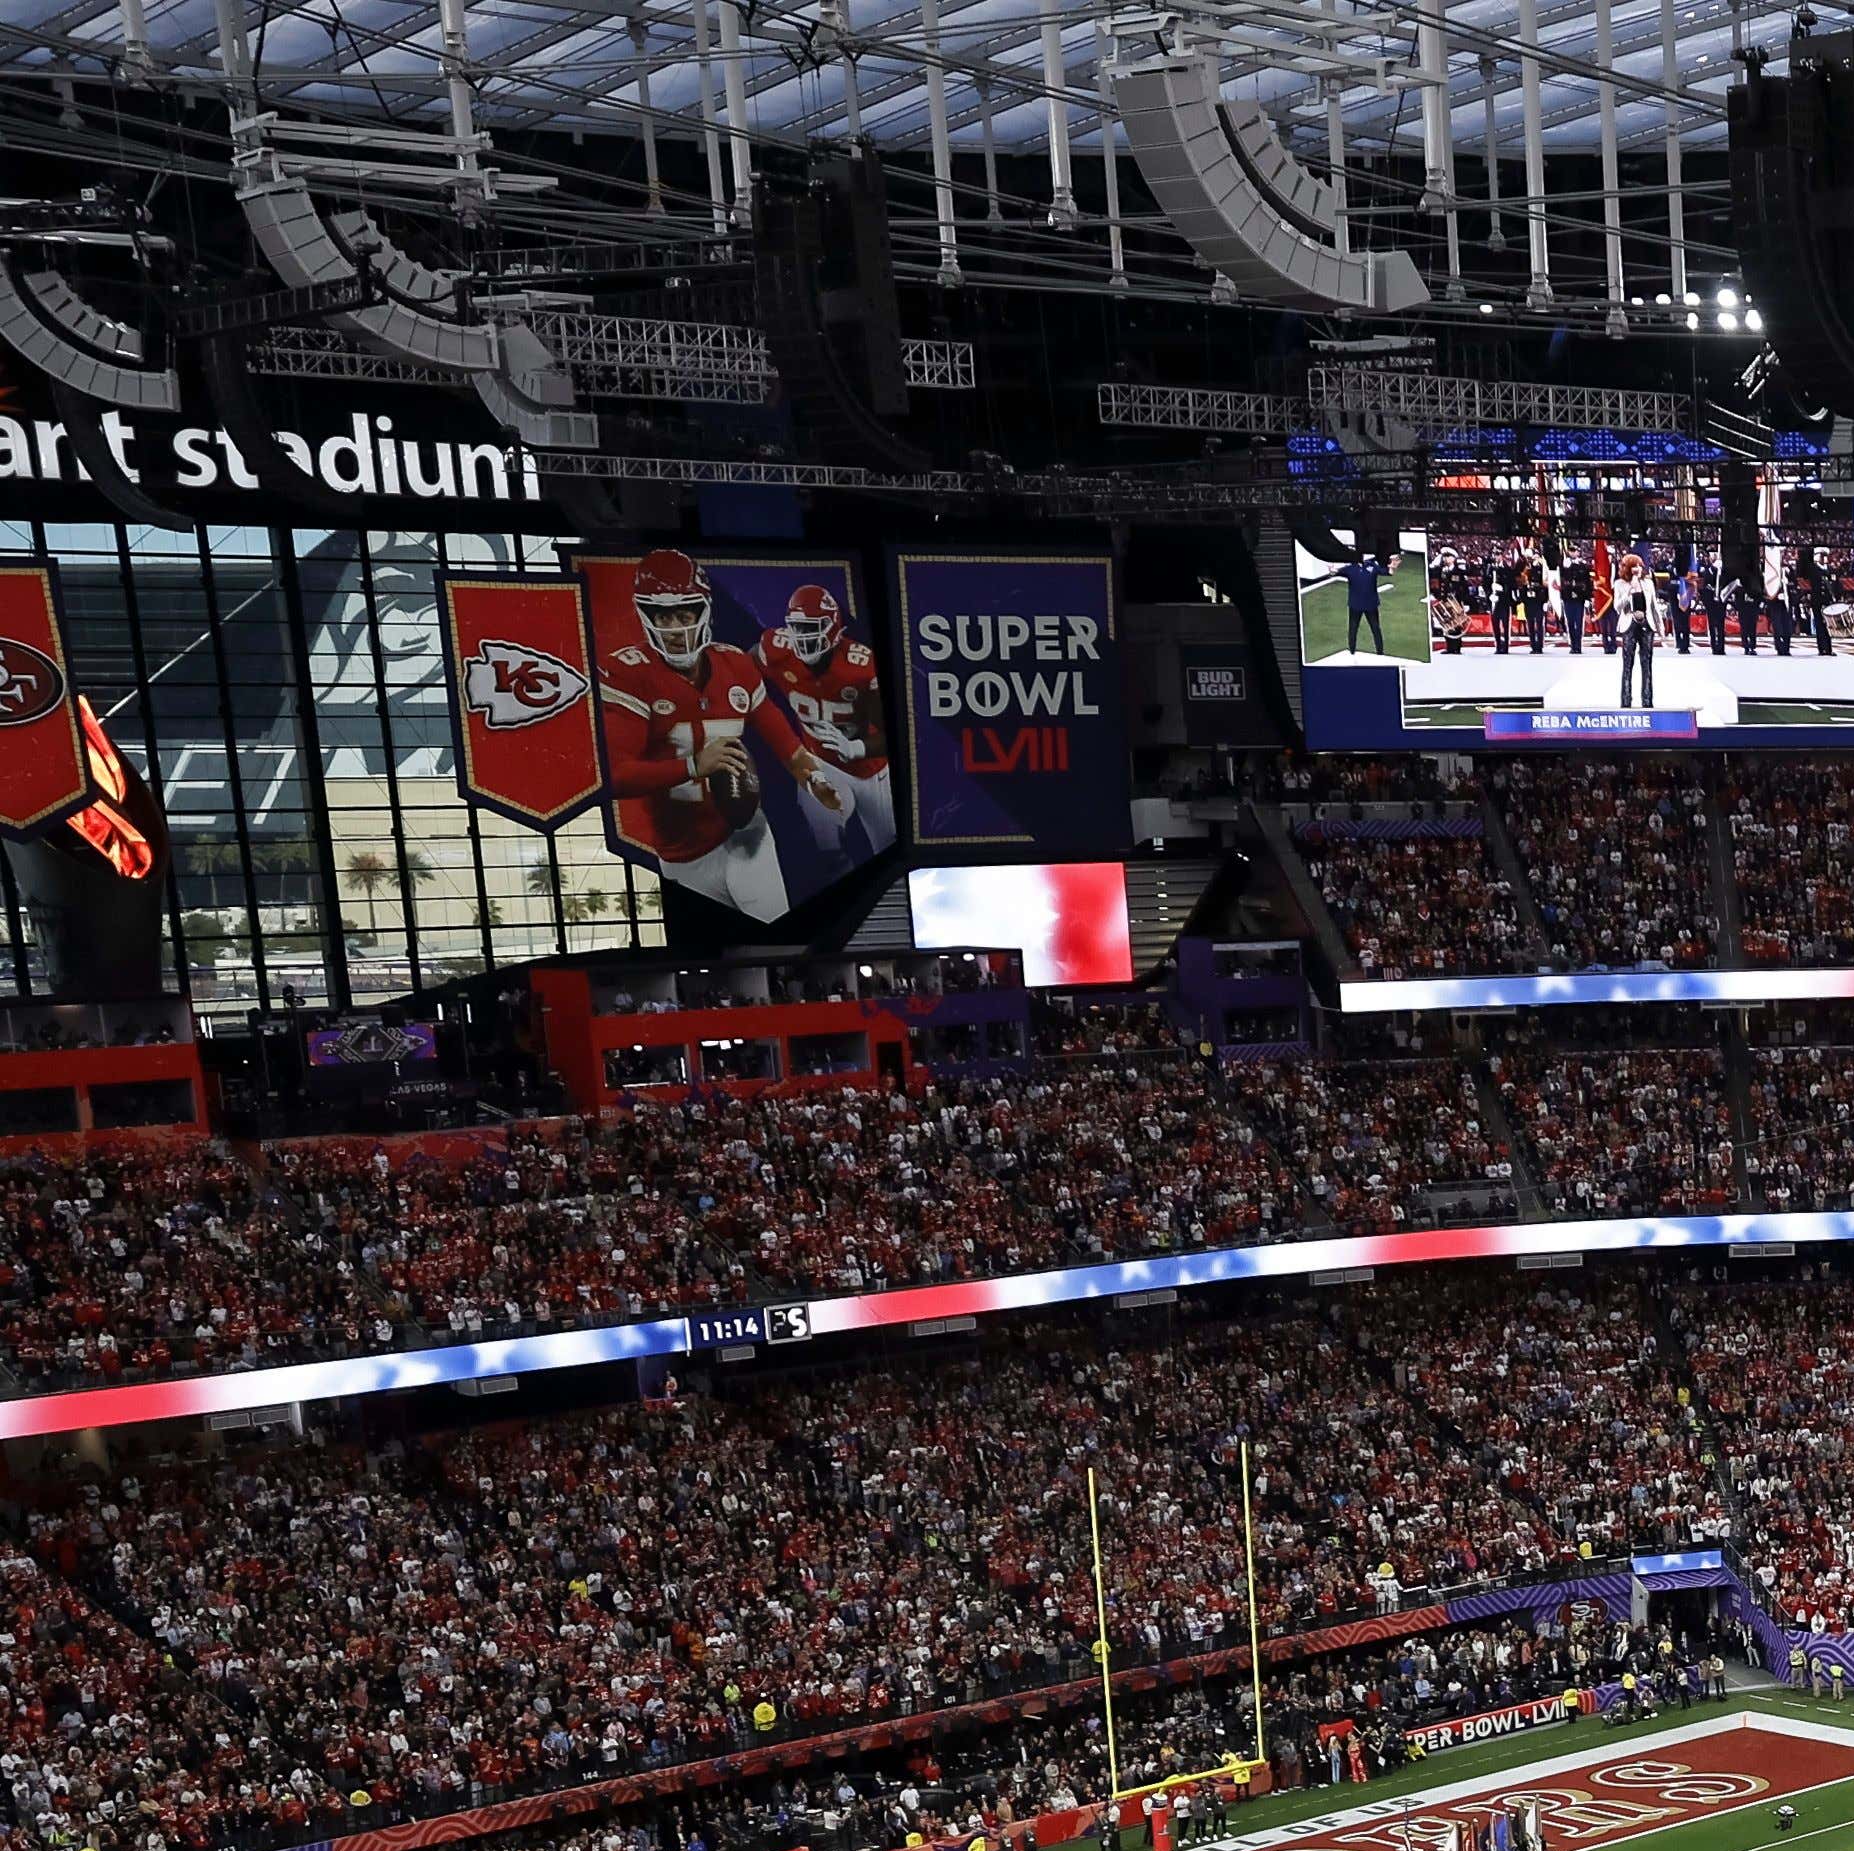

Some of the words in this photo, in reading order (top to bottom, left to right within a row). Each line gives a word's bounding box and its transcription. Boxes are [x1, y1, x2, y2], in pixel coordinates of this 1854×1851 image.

[918, 614, 1101, 661] SUPER
[491, 660, 562, 708] KC
[928, 671, 1100, 717] BOWL
[1191, 683, 1241, 697] LIGHT
[1197, 671, 1234, 684] BUD
[1532, 715, 1572, 729] REBA
[1576, 715, 1652, 729] McENTIRE
[962, 727, 1070, 773] LVIII
[700, 1317, 759, 1341] 11:14
[1462, 1709, 1526, 1741] BOWL
[1284, 1819, 1349, 1837] OF
[1364, 1798, 1425, 1815] US
